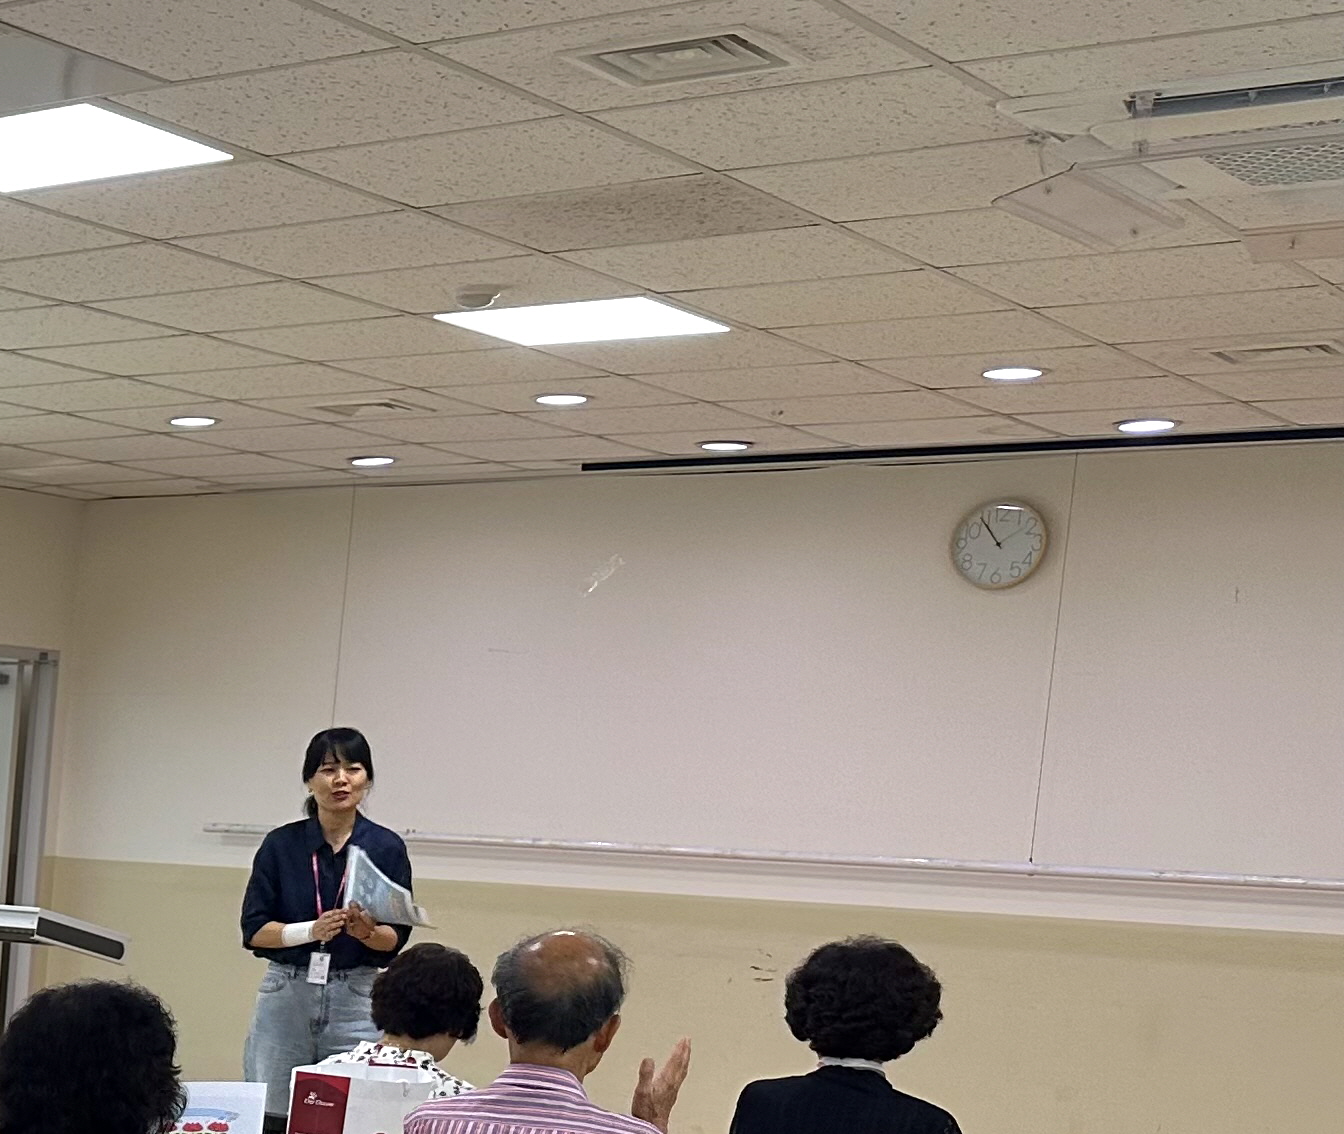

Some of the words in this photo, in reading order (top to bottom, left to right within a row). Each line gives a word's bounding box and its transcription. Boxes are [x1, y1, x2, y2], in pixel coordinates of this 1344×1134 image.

[1024, 516, 1038, 536] 2
[1031, 533, 1043, 552] 3
[960, 553, 973, 572] 8
[1021, 551, 1033, 567] 4
[976, 562, 988, 581] 7
[990, 567, 1002, 585] 6
[1009, 561, 1022, 578] 5
